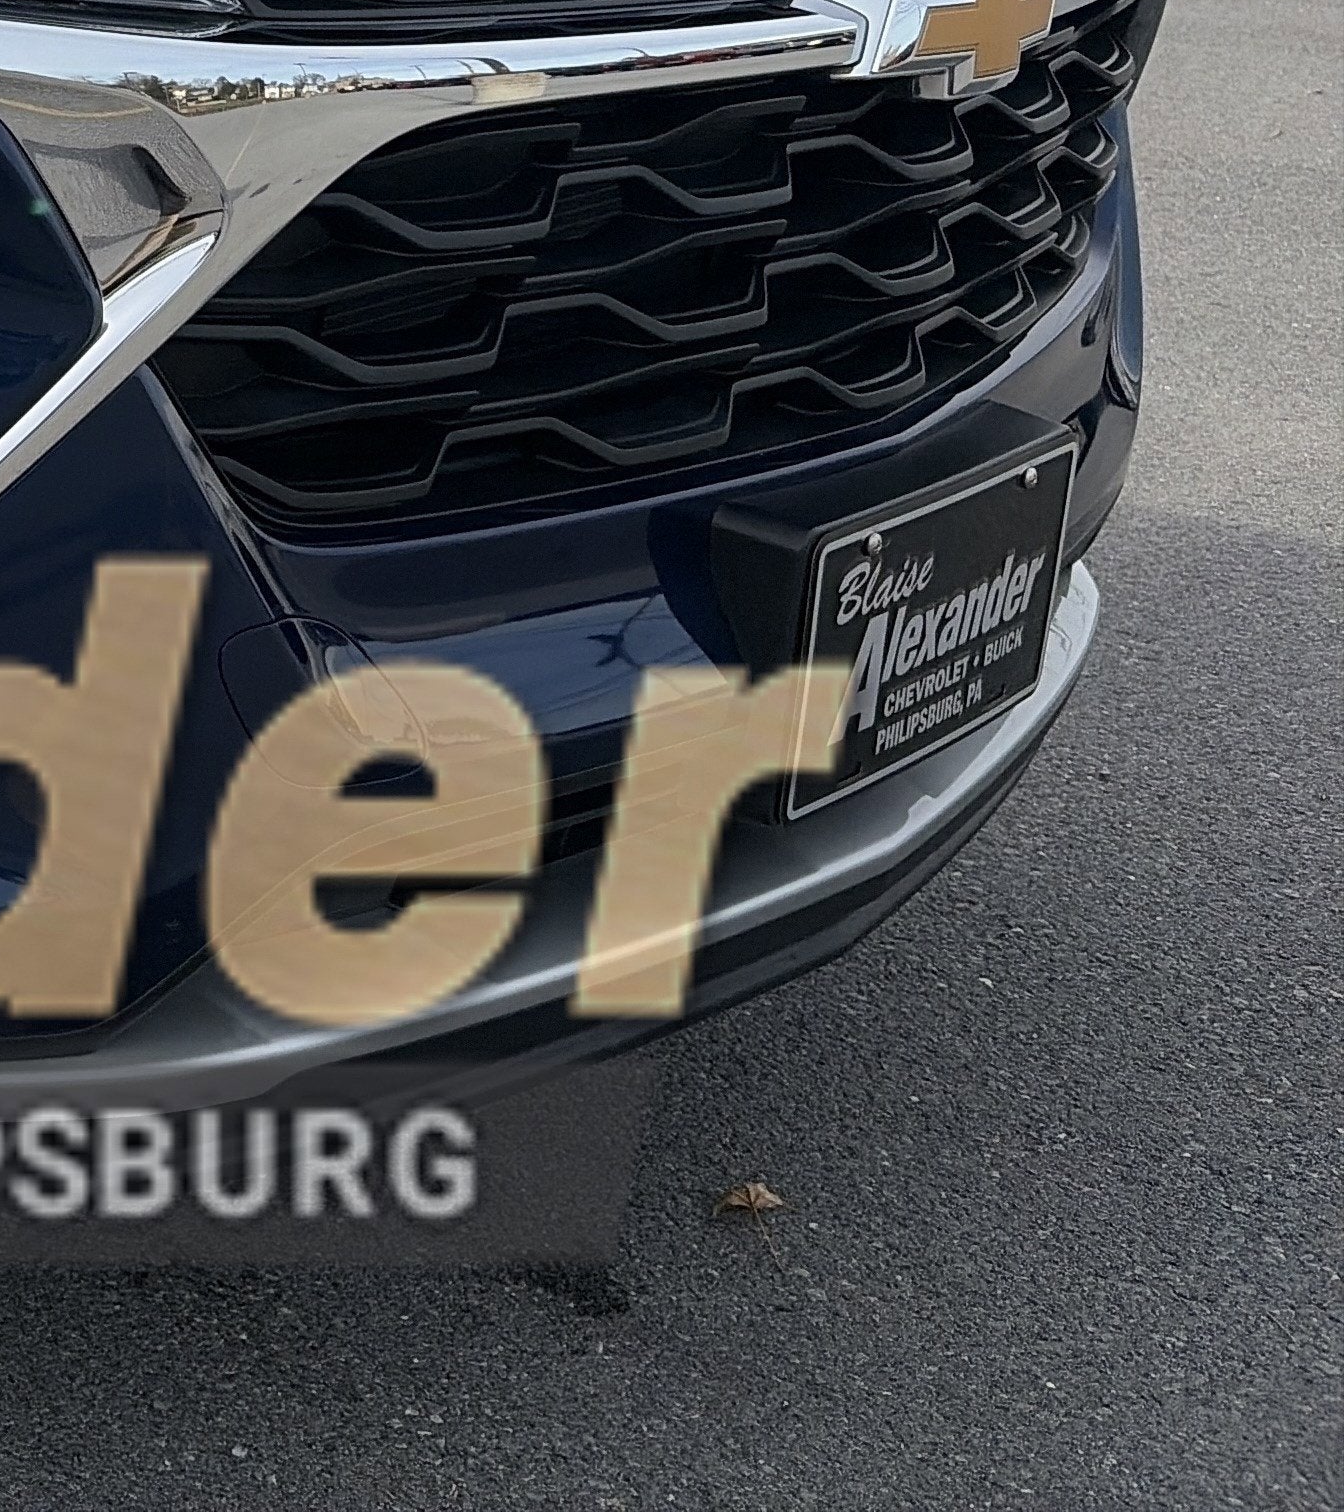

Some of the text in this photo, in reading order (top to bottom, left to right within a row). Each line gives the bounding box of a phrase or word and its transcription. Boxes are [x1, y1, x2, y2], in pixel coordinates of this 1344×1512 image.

[836, 555, 934, 626] Blaise
[826, 552, 1046, 747] Alexander
[883, 626, 1025, 718] CHEVROLET BUICK
[874, 678, 983, 756] PHILIPSBURG, PA
